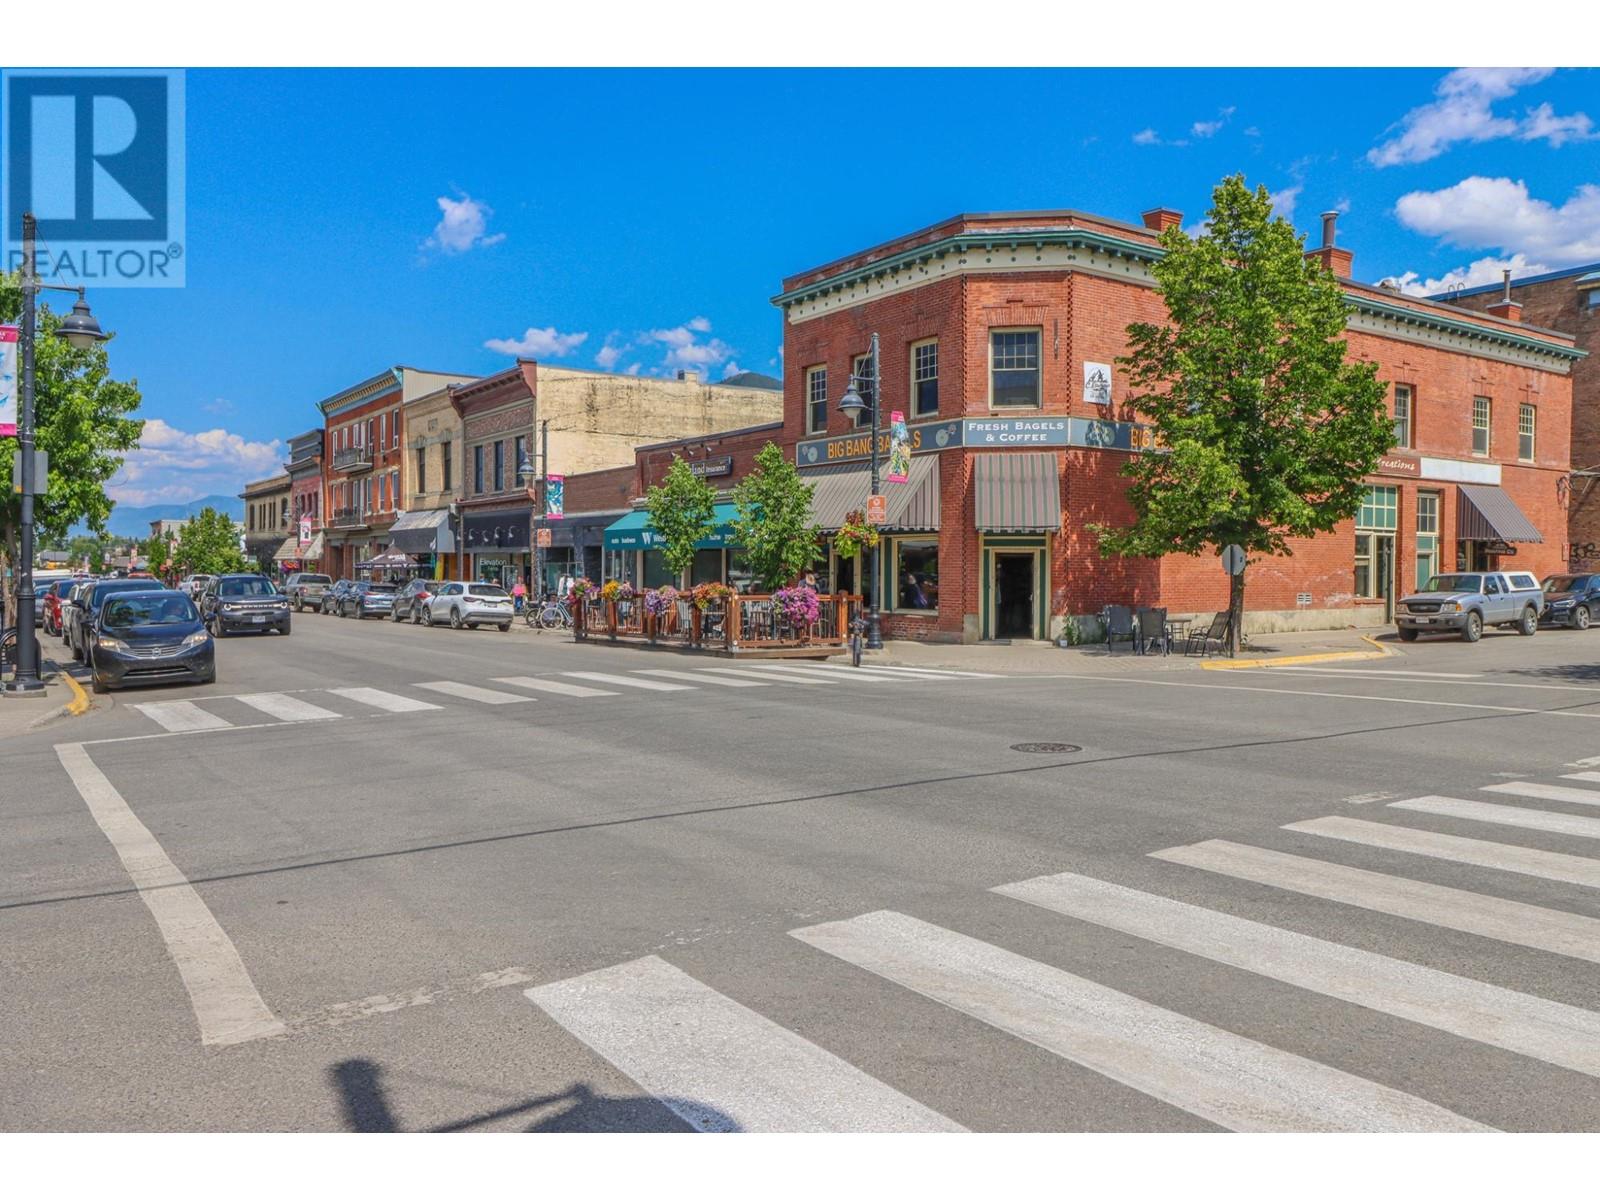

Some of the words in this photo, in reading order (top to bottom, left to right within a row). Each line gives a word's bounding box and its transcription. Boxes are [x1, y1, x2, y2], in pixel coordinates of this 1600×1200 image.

[968, 422, 1009, 431] FRESH
[1015, 421, 1065, 431] BAGELS
[985, 433, 995, 442] &
[999, 433, 1048, 442] COFFEE
[827, 441, 845, 459] BIG
